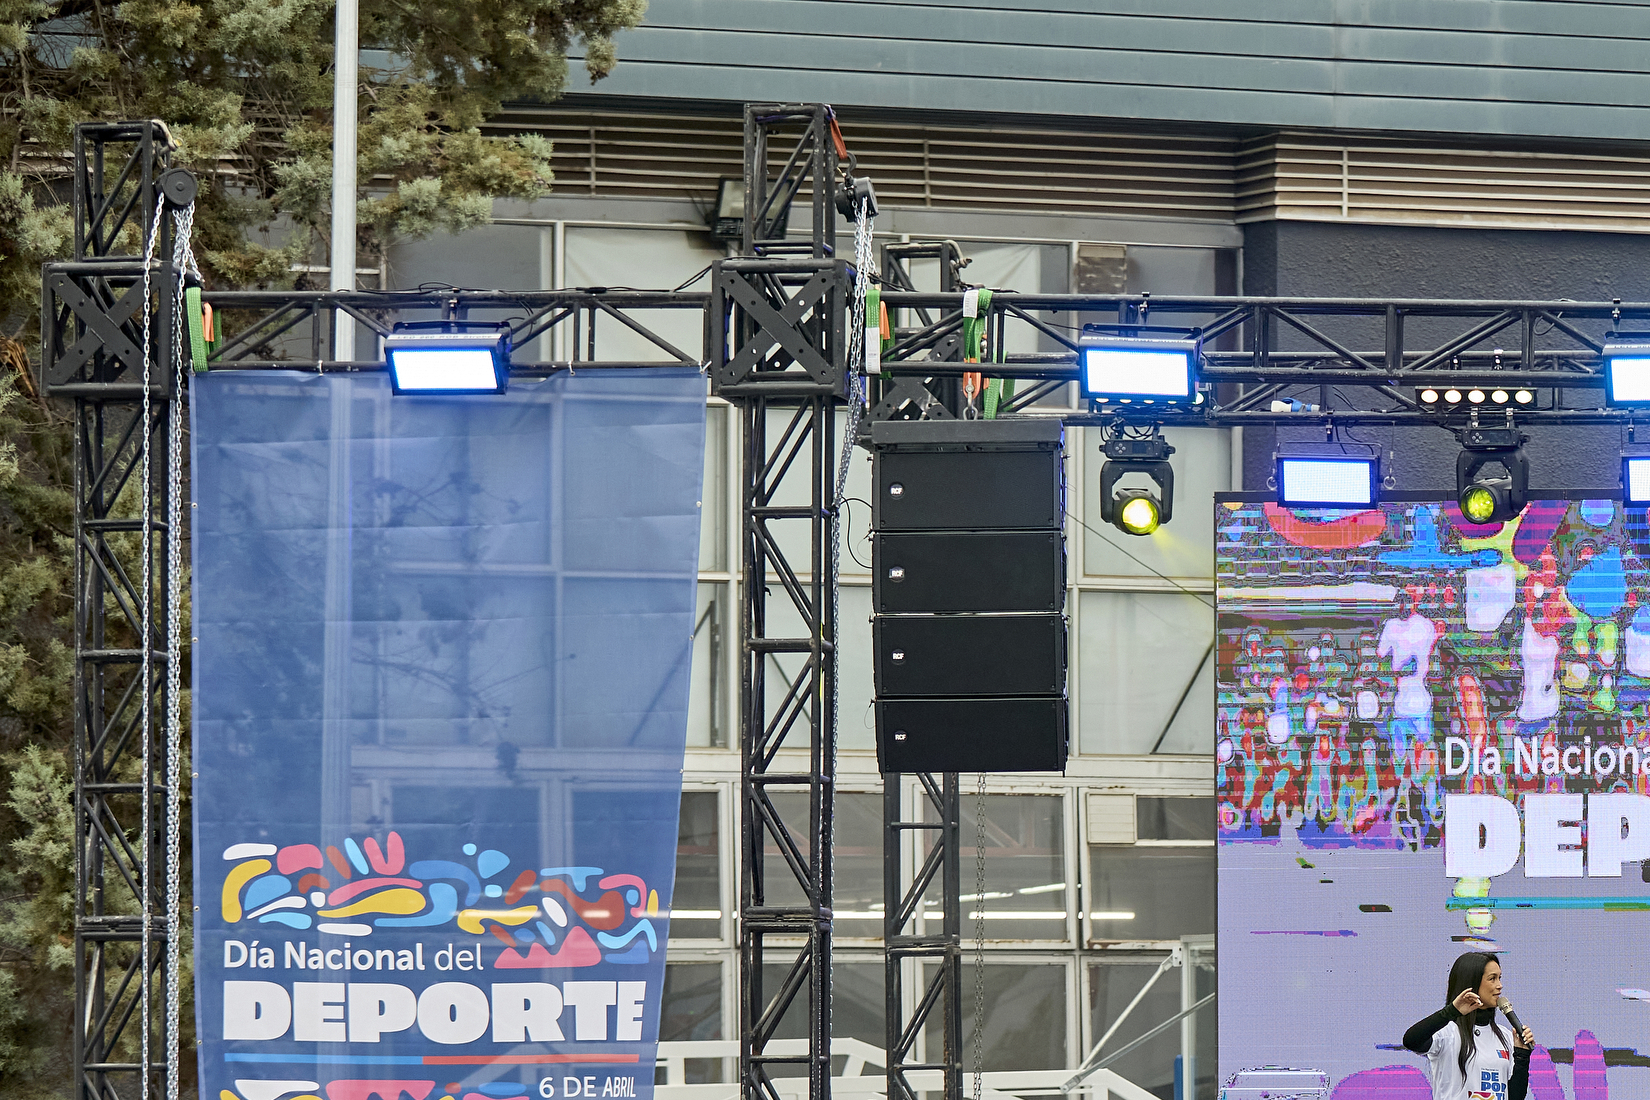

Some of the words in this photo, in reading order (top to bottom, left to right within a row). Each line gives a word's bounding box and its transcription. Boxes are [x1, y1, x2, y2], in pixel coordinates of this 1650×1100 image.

[224, 940, 276, 969] Día
[284, 941, 426, 971] Nacional
[434, 942, 484, 971] del
[223, 980, 647, 1044] DEPORTE
[539, 1077, 555, 1099] 6
[564, 1077, 597, 1098] DE
[602, 1077, 636, 1098] ABRIL
[1481, 1071, 1499, 1081] DE
